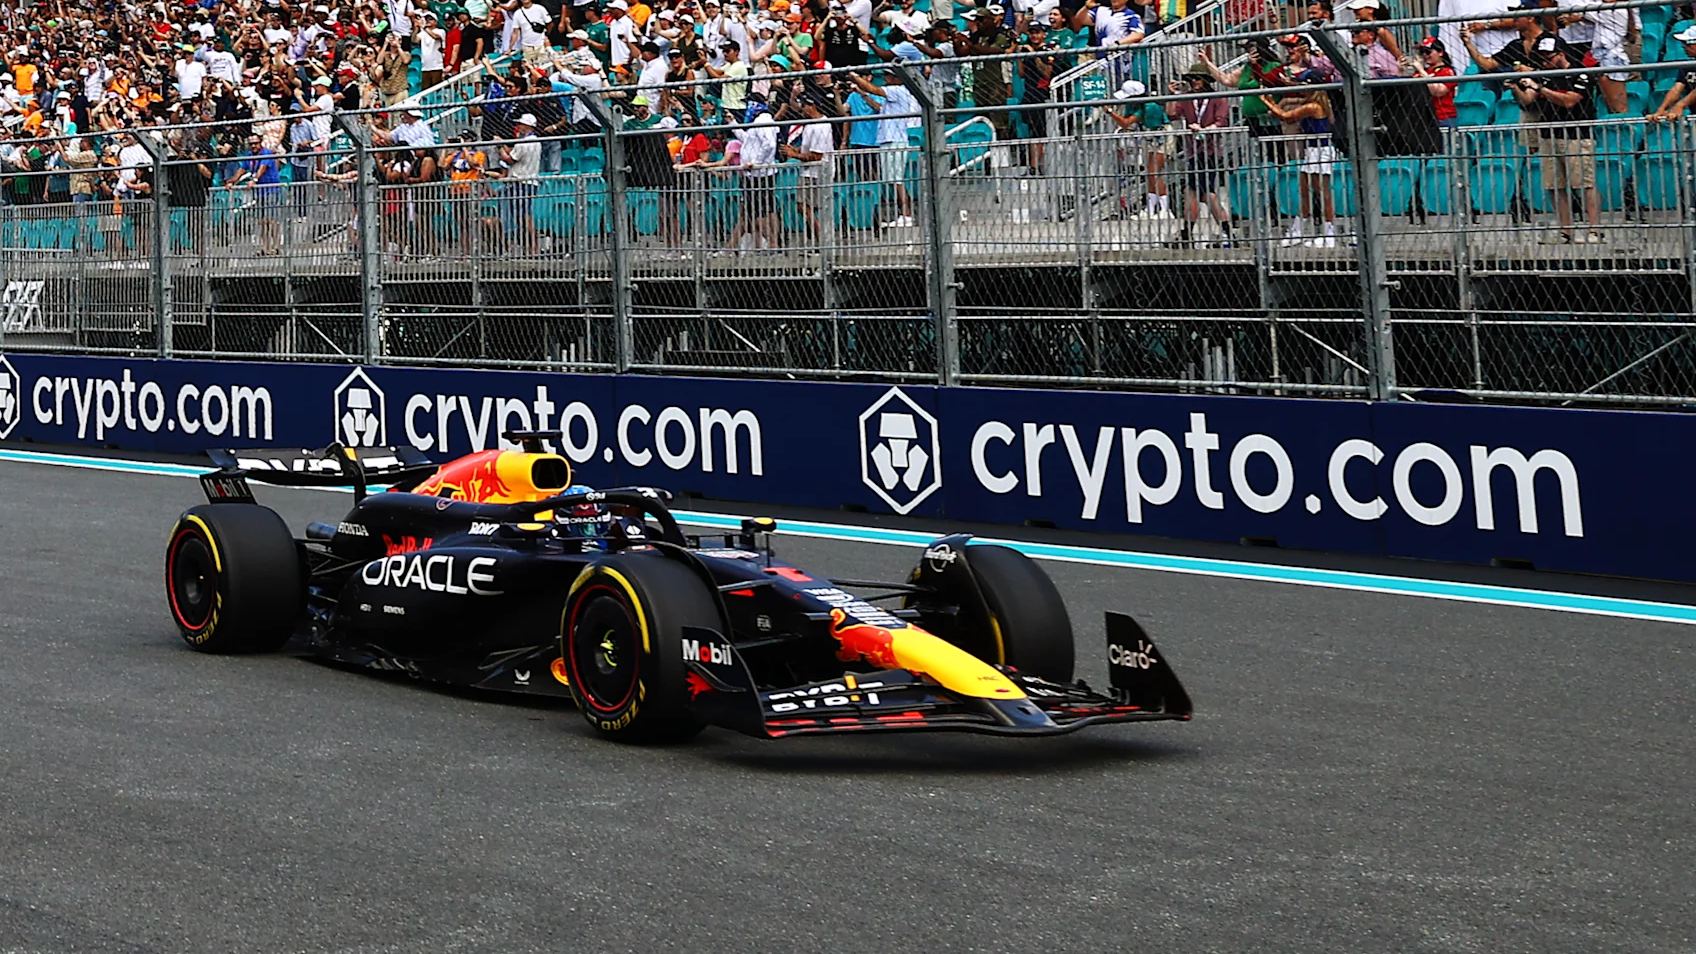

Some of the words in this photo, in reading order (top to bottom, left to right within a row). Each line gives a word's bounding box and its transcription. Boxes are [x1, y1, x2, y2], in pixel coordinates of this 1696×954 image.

[33, 368, 273, 440] crypto.com
[404, 385, 765, 476] crypto.com
[204, 478, 239, 497] Mobil
[970, 411, 1585, 538] crypto.com
[337, 522, 370, 537] HONDA
[361, 553, 505, 595] ORACLE
[681, 638, 733, 666] Mobil
[1107, 642, 1152, 670] Claro
